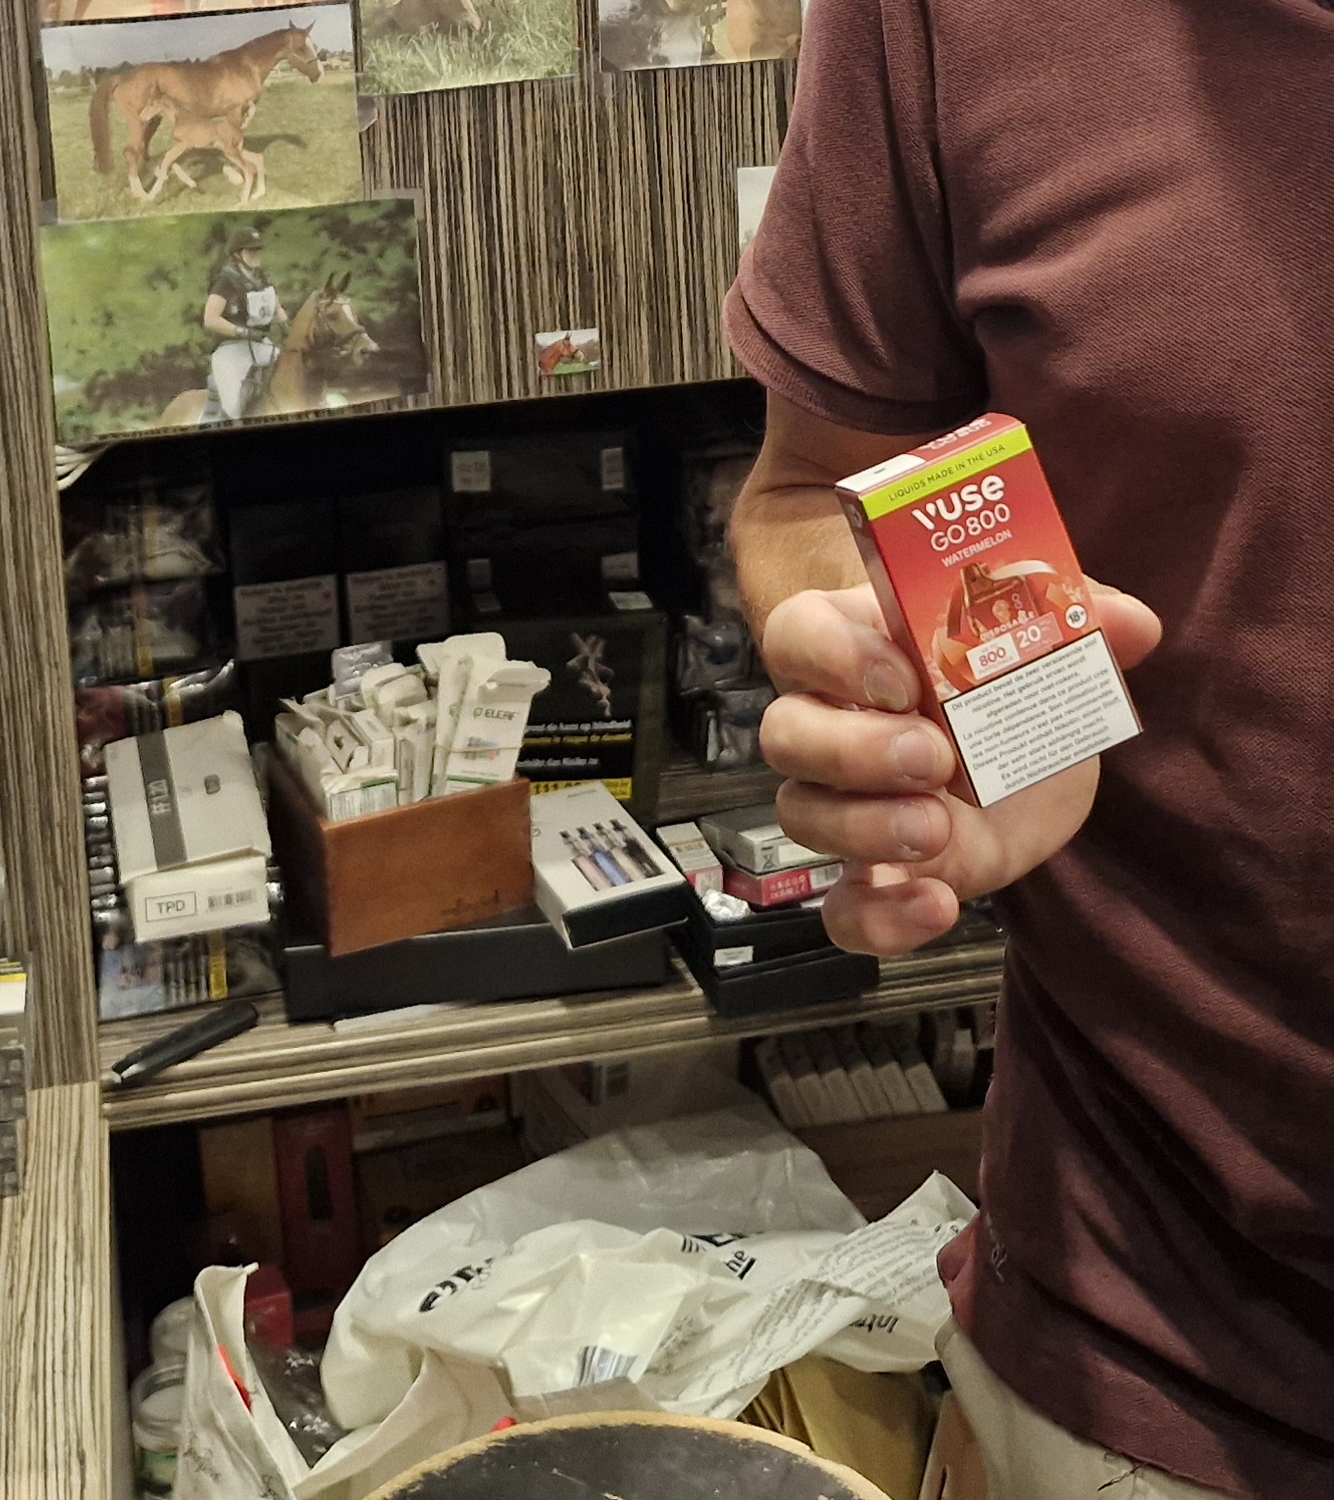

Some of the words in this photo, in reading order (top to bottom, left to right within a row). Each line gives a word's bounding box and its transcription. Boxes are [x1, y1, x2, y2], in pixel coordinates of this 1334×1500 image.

[888, 479, 927, 502] LIQUIDS
[927, 466, 955, 484] MADE
[954, 462, 966, 475] IN
[966, 453, 985, 468] THE
[986, 443, 1006, 459] USA
[966, 503, 1011, 537] 800
[941, 529, 1012, 568] WATERMELON
[1013, 623, 1044, 649] 20
[977, 645, 1008, 668] 800
[156, 899, 186, 914] TPD
